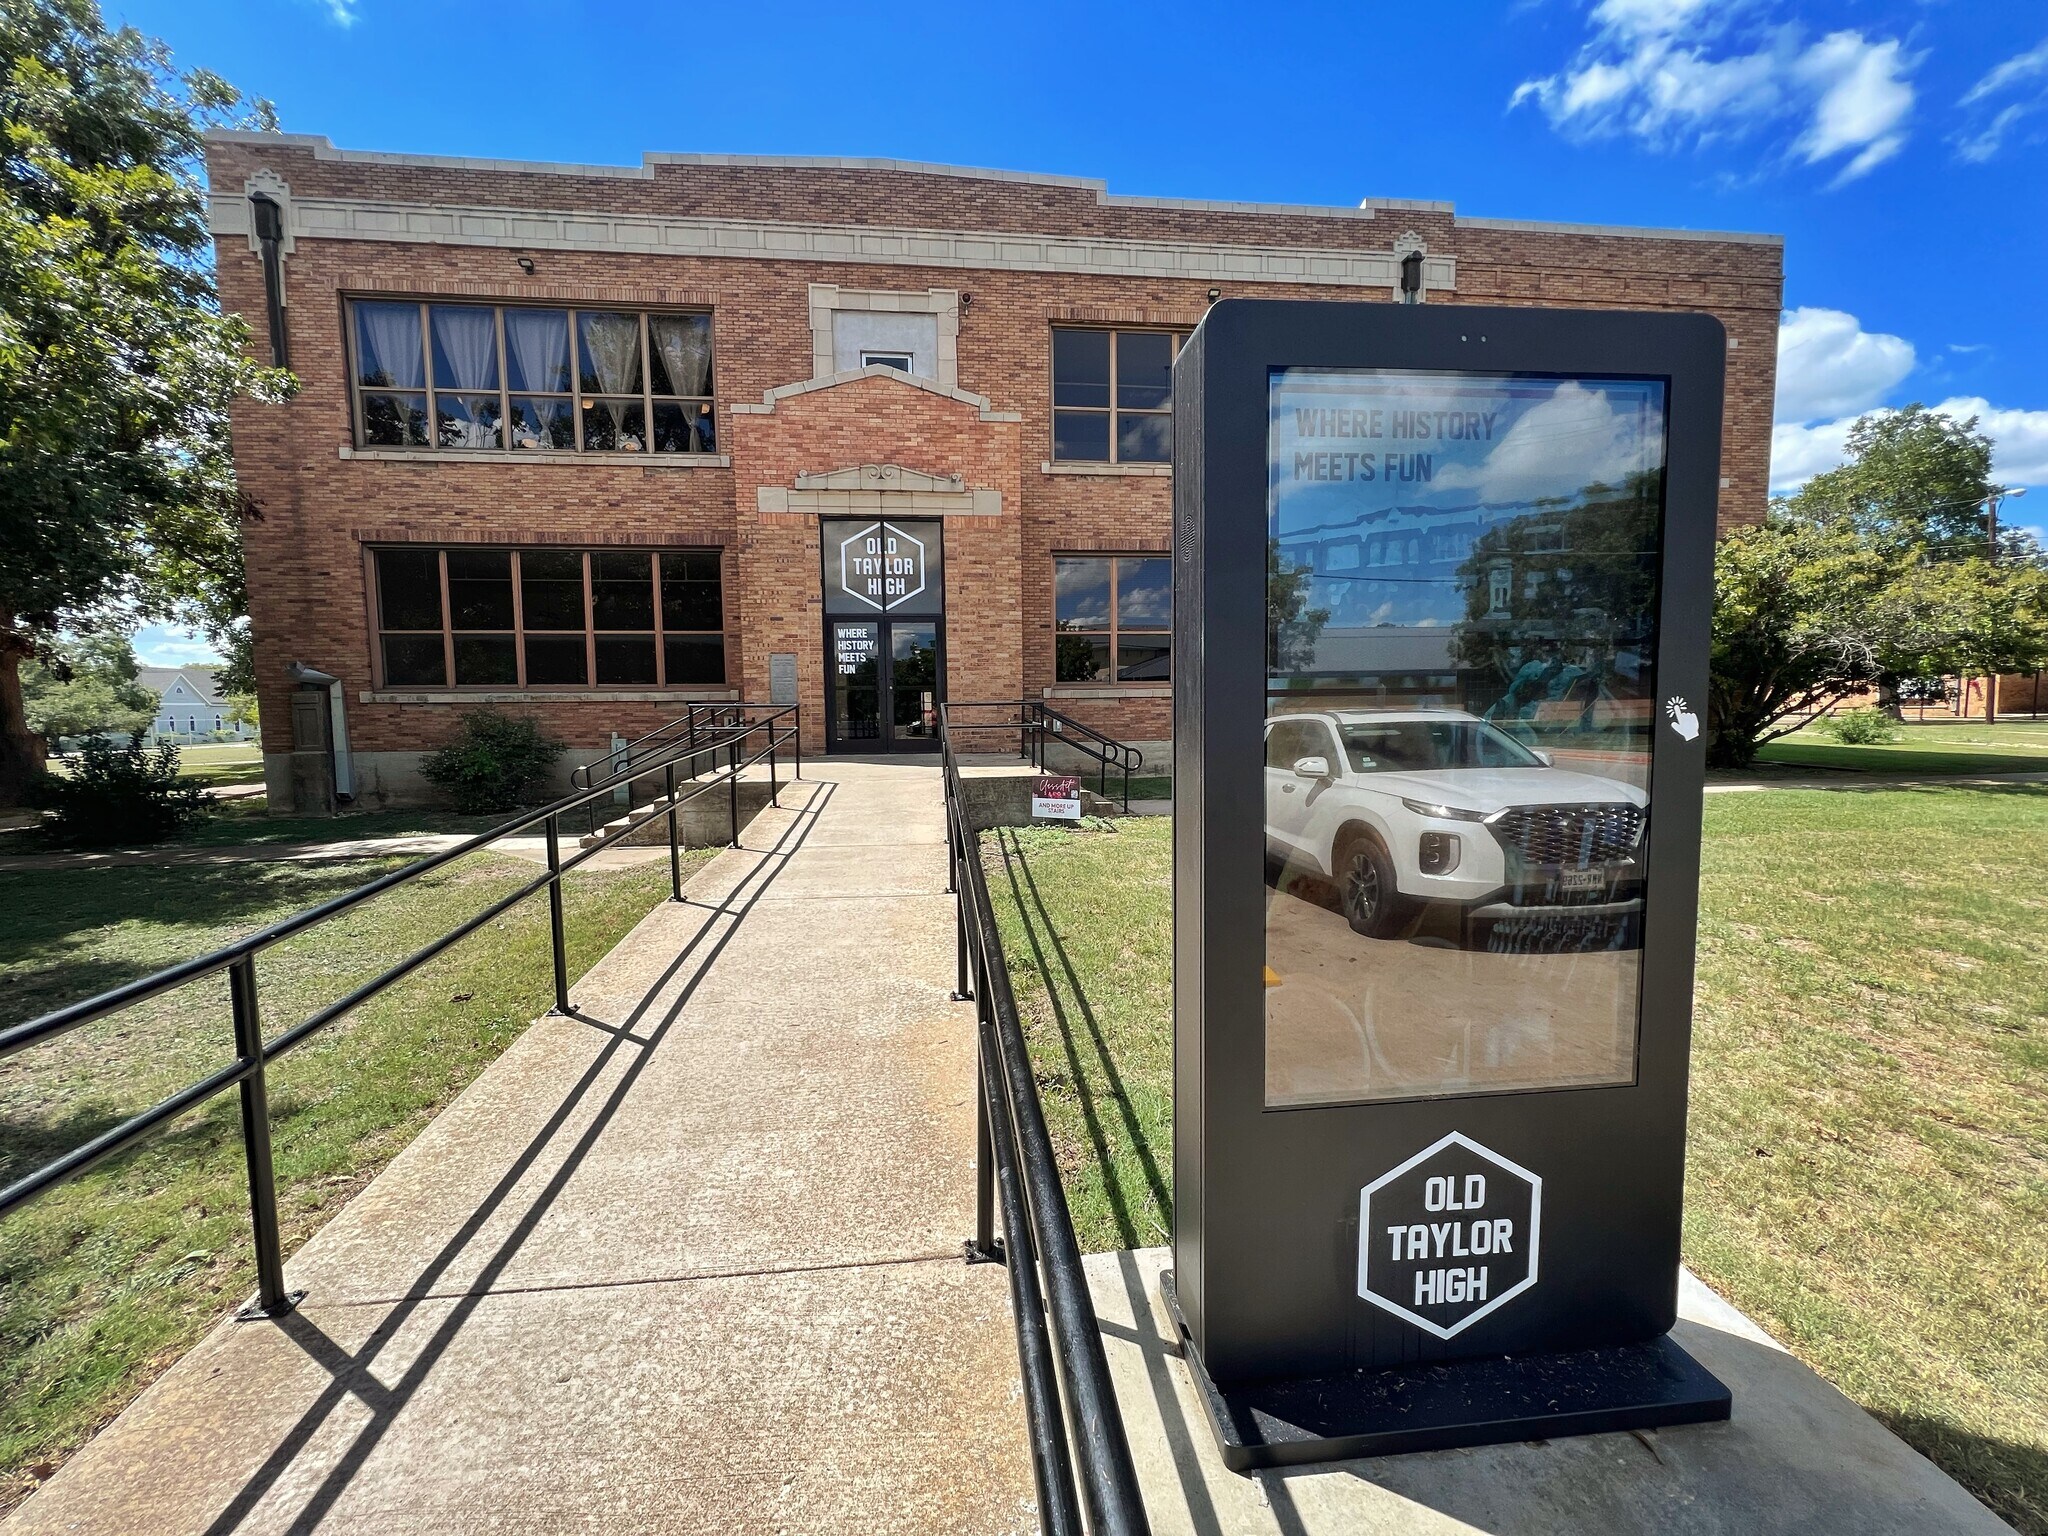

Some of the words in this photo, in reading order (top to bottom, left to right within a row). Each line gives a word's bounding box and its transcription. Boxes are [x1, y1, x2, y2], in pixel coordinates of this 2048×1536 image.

[1295, 407, 1383, 439] WHERE
[1391, 410, 1498, 441] HISTORY
[1294, 452, 1376, 482] MEETS
[1384, 453, 1432, 482] FUN
[866, 537, 897, 555] OLD
[852, 557, 914, 575] TAYLOR
[867, 578, 906, 595] HIGH
[837, 628, 868, 639] WHERE
[837, 640, 874, 651] HISTORY
[838, 652, 867, 663] MEETS
[838, 664, 856, 675] FUN
[1424, 1174, 1486, 1212] OLD
[1387, 1218, 1513, 1261] TAYLOR
[1414, 1266, 1488, 1306] HIGH
